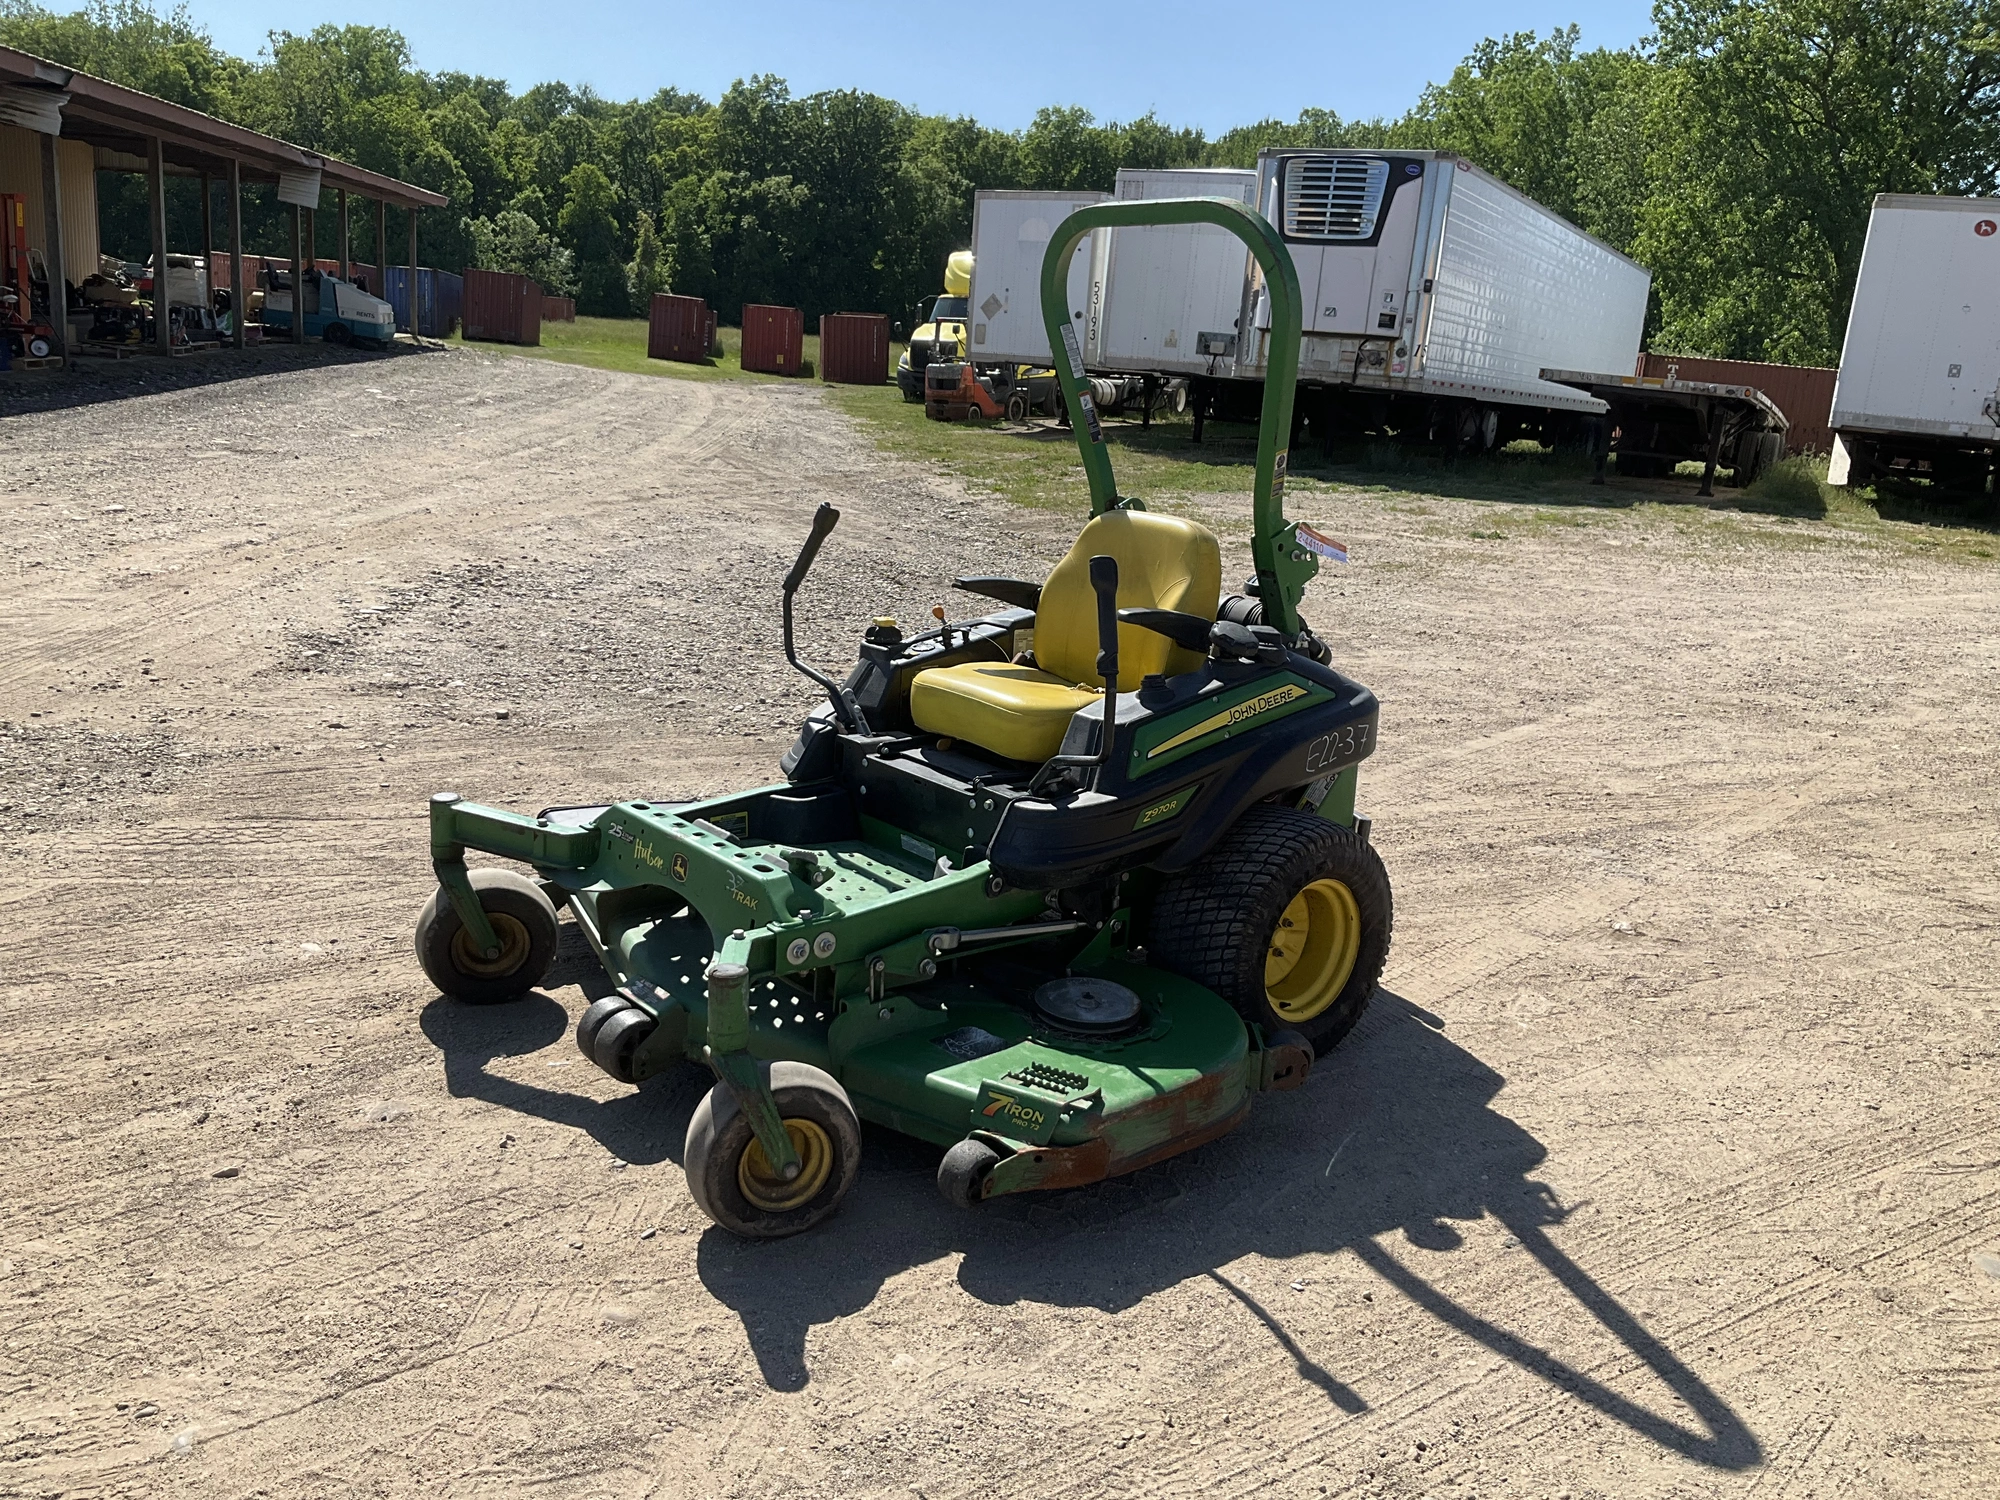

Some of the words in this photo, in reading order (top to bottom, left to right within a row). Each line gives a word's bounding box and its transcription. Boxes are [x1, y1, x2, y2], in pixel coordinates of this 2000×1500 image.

[1089, 281, 1100, 341] 53193
[1297, 531, 1324, 554] 2-44110
[1227, 702, 1257, 724] JOHN
[1257, 688, 1295, 711] DEERE
[1305, 724, 1370, 772] E22-37
[1142, 800, 1177, 823] Z970R
[608, 822, 624, 838] 25
[731, 888, 759, 911] TRAK
[1011, 1117, 1028, 1127] PRO
